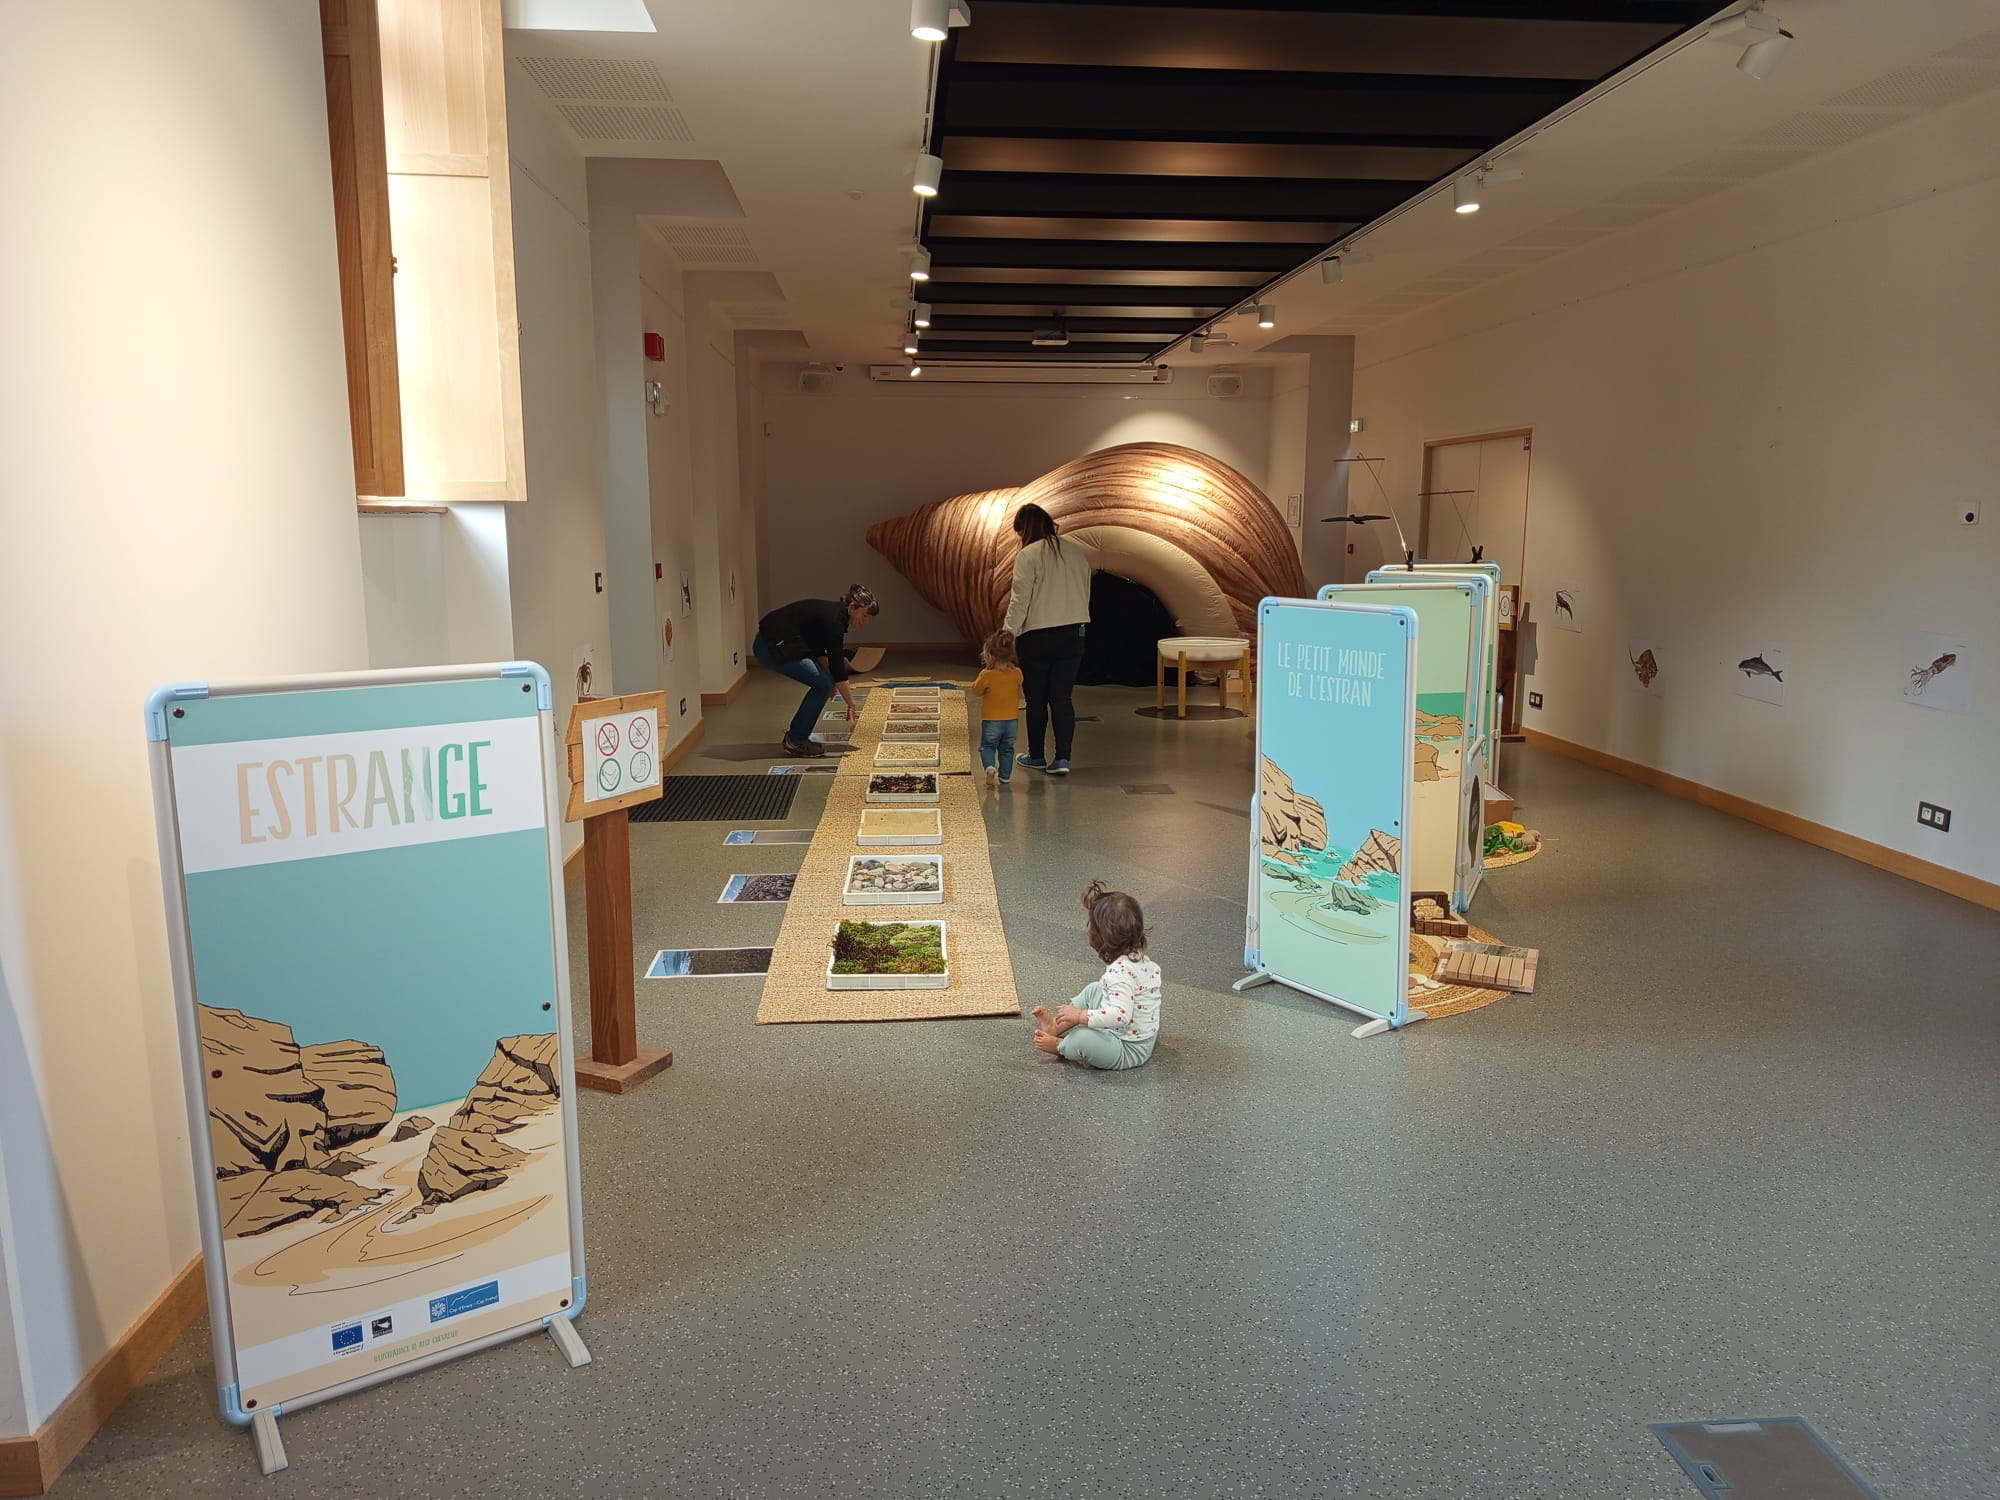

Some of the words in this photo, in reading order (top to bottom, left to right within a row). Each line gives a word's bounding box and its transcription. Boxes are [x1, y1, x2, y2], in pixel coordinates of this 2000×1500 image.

[1278, 641, 1292, 668] LE
[1297, 643, 1332, 673] PETIT
[1338, 647, 1387, 679] MONDE
[1288, 671, 1303, 698] DE
[1310, 673, 1372, 708] L'ESTRAN
[236, 740, 493, 845] ESTRANGE
